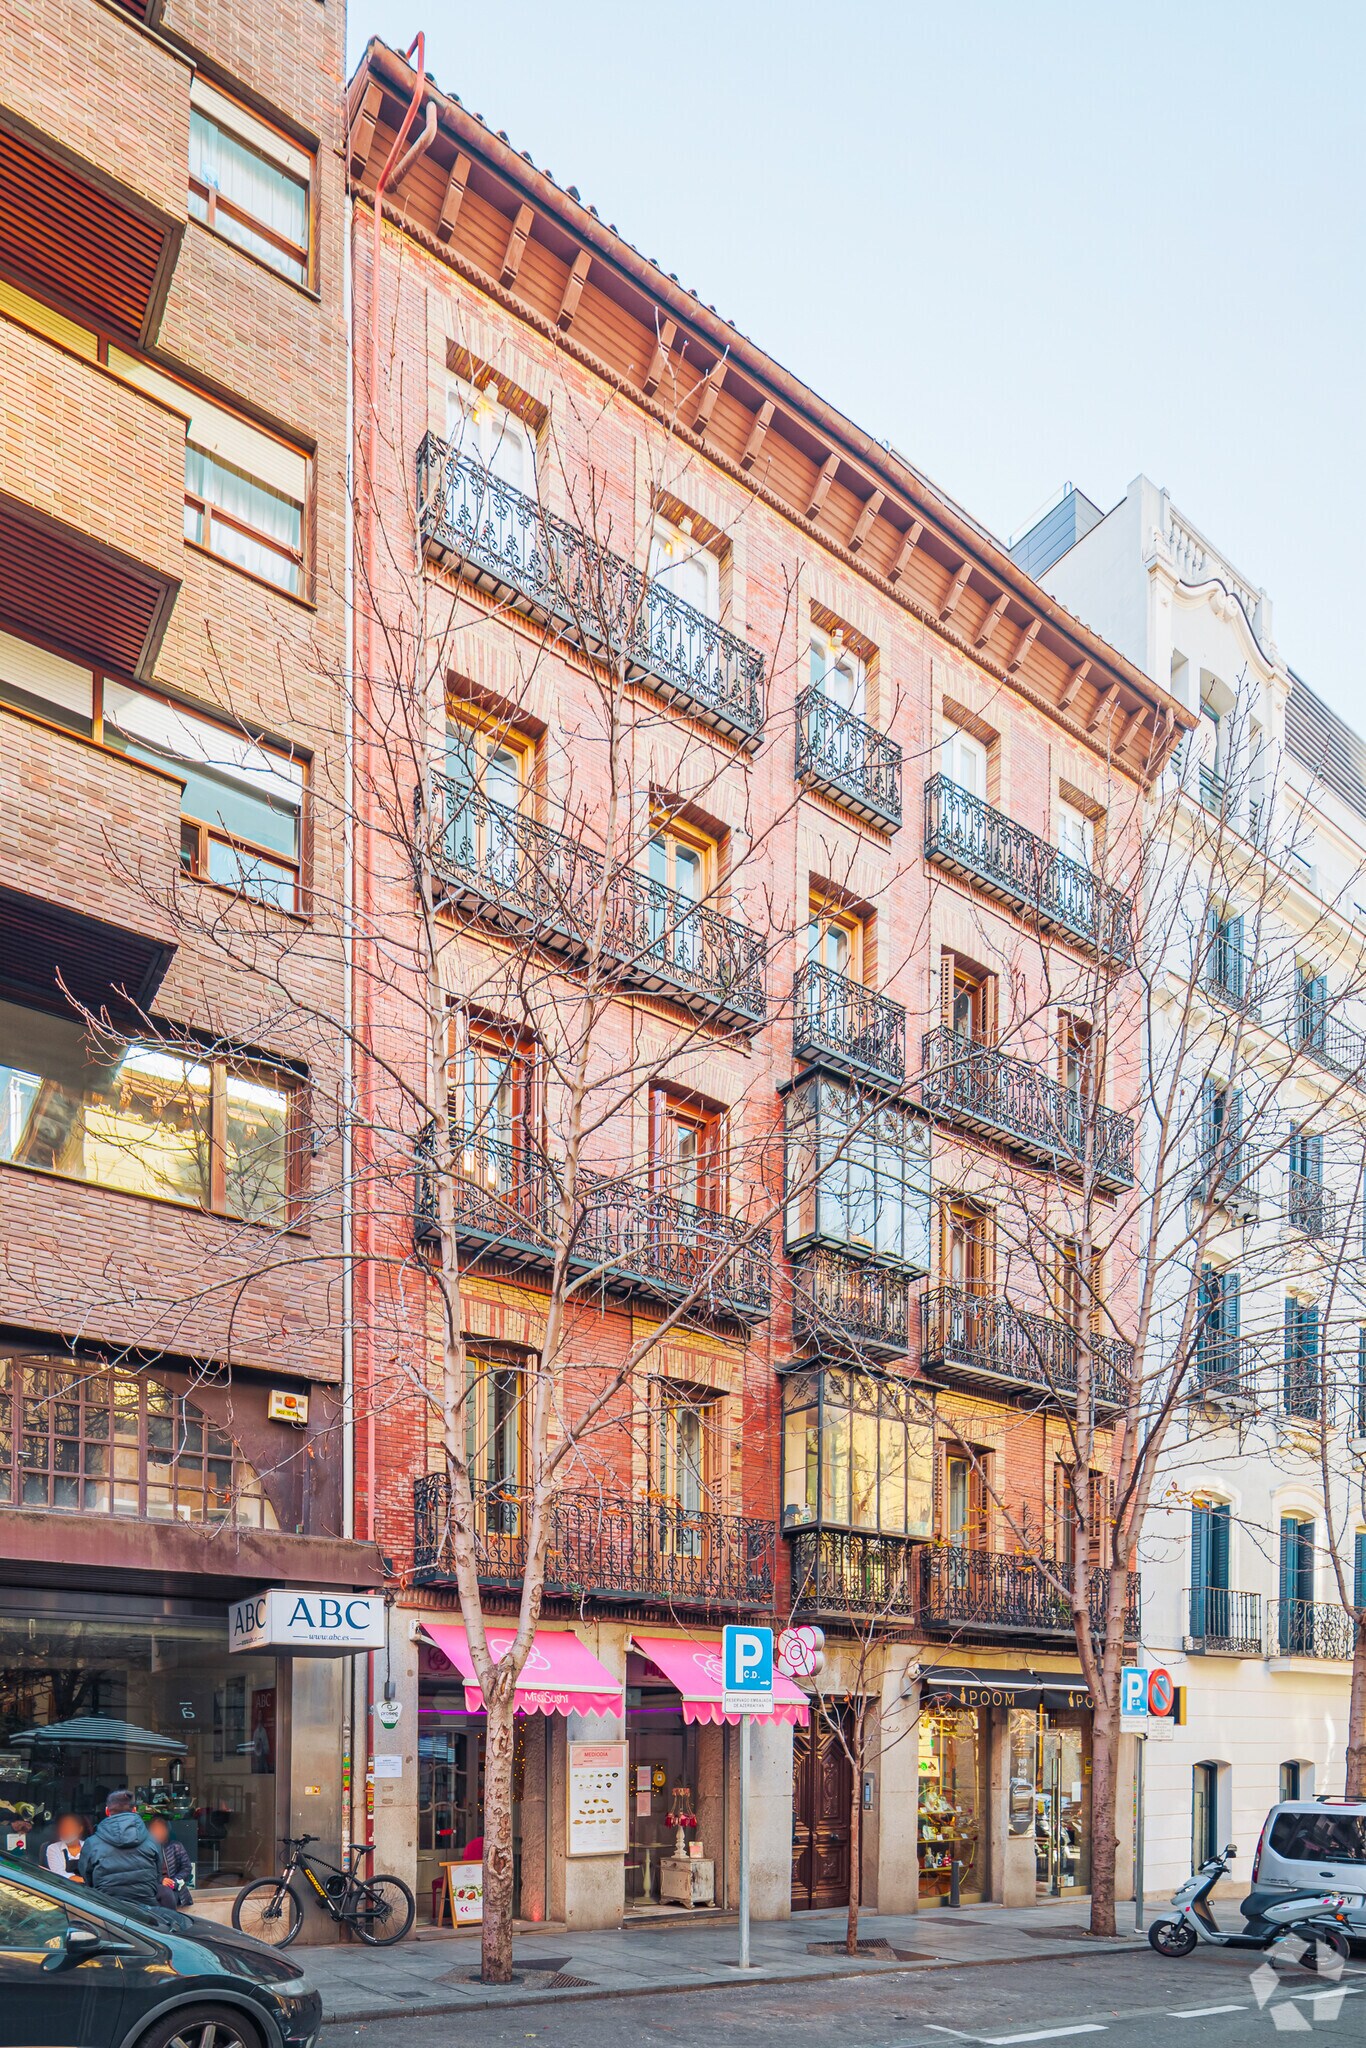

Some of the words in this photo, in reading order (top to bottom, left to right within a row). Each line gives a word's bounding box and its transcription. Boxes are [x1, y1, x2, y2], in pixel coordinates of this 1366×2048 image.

[234, 1599, 266, 1636] ABC
[287, 1597, 370, 1630] ABC
[308, 1633, 350, 1641] www.abc.es
[735, 1633, 763, 1683] P
[743, 1670, 760, 1679] C.D.
[969, 1689, 1015, 1707] POOM
[1076, 1694, 1095, 1709] PO
[1127, 1673, 1143, 1711] P
